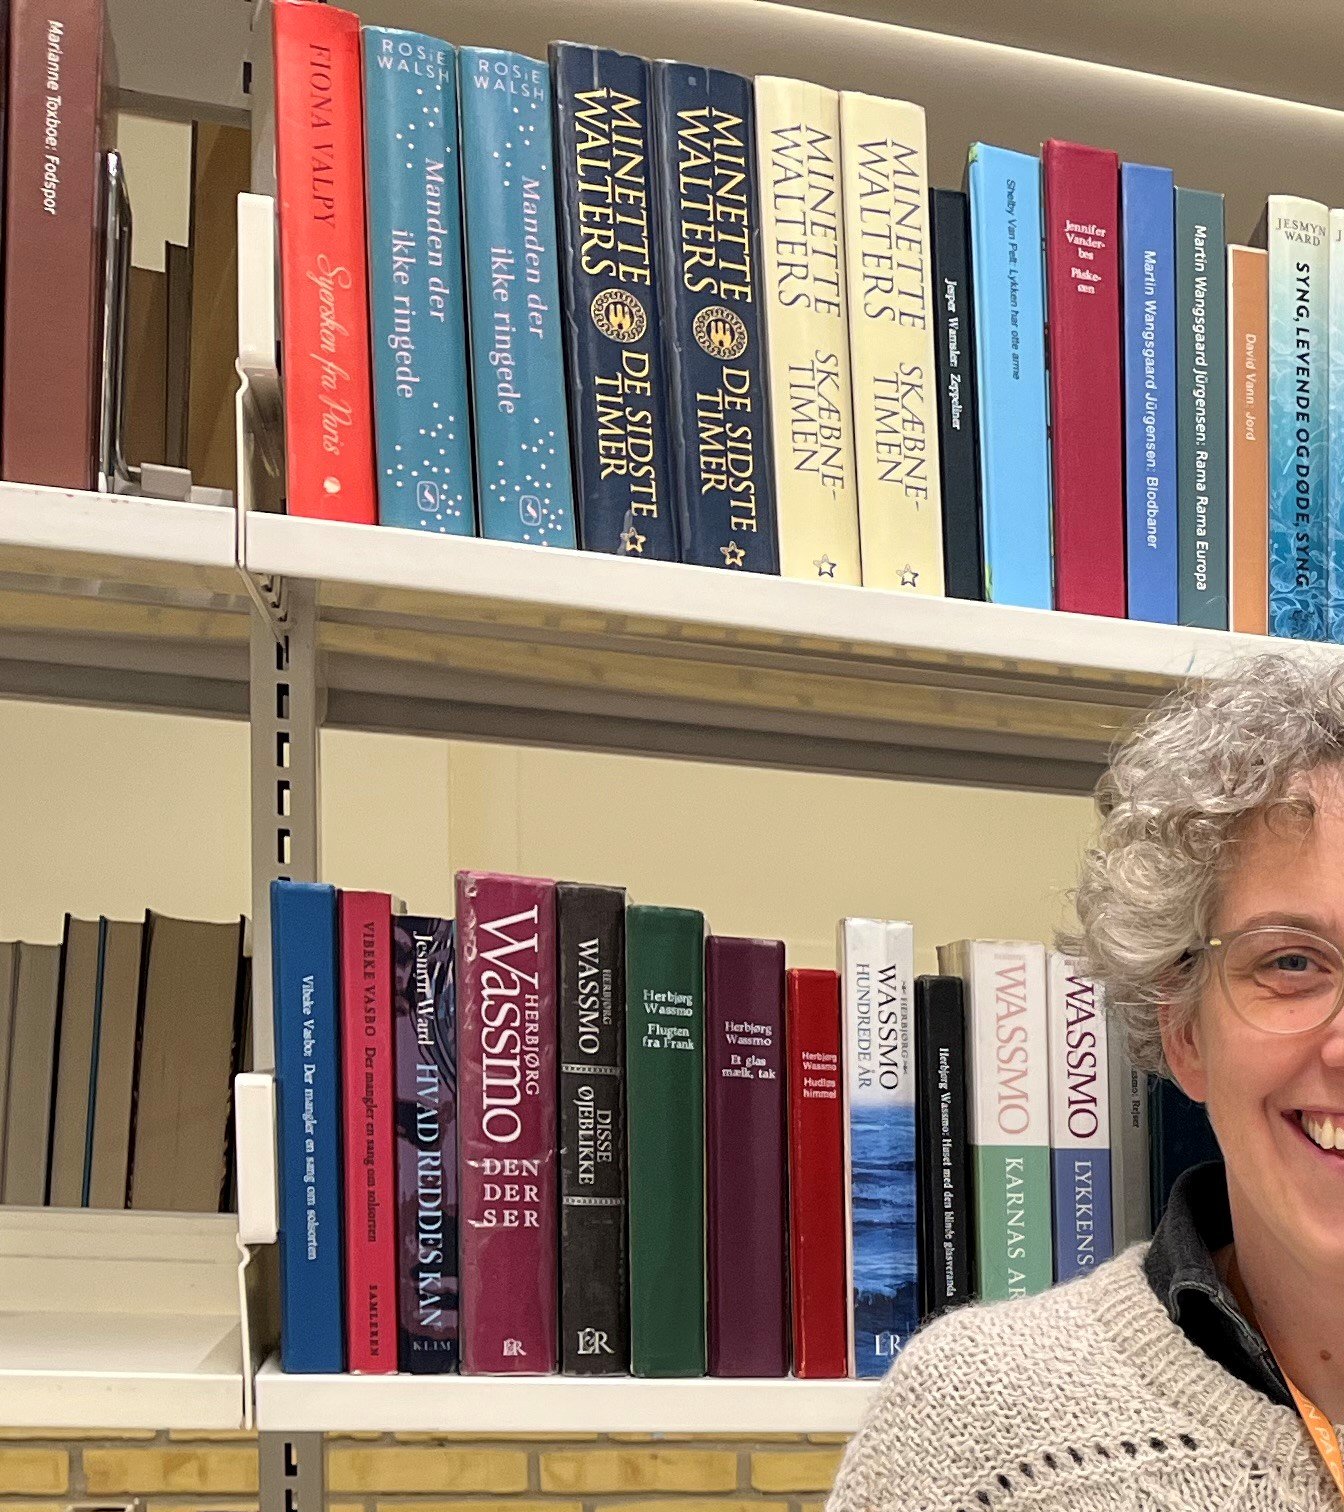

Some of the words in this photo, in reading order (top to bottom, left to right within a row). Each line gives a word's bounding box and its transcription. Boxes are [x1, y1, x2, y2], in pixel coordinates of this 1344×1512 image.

[47, 20, 66, 91] Marianne
[308, 42, 331, 130] FIONA
[376, 54, 450, 83] WALSH
[41, 155, 60, 215] Fodspor
[312, 143, 335, 226] VALPY
[426, 158, 450, 267] Manden
[574, 88, 616, 276] WALTERS
[609, 88, 652, 286] MINETTE
[771, 124, 811, 307] WALTERS
[806, 125, 841, 318] MINETTE
[391, 229, 411, 285] ikke
[1276, 217, 1326, 237] JESMYN
[1284, 231, 1321, 248] WARD
[305, 253, 351, 348] Syersken
[430, 276, 450, 323] der
[1143, 250, 1157, 296] Martin
[1294, 262, 1311, 323] SYNG,
[309, 351, 351, 391] fra
[389, 295, 420, 399] ringede
[622, 350, 651, 396] DE
[1143, 299, 1157, 390] Wangsgaard
[1295, 327, 1311, 422] LEVENDE
[318, 394, 353, 456] Paris
[595, 374, 628, 479] TIMER
[788, 365, 820, 472] TIMEN
[815, 350, 844, 501] SKÆBNE-
[1297, 424, 1310, 456] OG
[626, 408, 657, 518] SIDSTE
[1145, 476, 1159, 550] Blodbaner
[1297, 530, 1310, 587] SYNG
[479, 905, 538, 1144] Wassmo
[578, 938, 599, 1054] WASSMO
[725, 1020, 772, 1036] Herbjørg
[856, 963, 870, 1057] HUNDREDE
[878, 963, 899, 1090] WASSMO
[525, 993, 539, 1095] HERBJØRG
[725, 1034, 771, 1047] Wassmo
[731, 1055, 746, 1066] Et
[748, 1055, 766, 1068] glas
[757, 1067, 775, 1079] tak
[995, 959, 1029, 1135] WASSMO
[1064, 973, 1098, 1139] WASSMO
[416, 1065, 437, 1142] HVAD
[579, 1086, 593, 1185] ØJEBLIKKE
[596, 1110, 611, 1163] DISSE
[417, 1150, 442, 1261] REDDES
[483, 1159, 538, 1177] DEN
[484, 1183, 539, 1203] DER
[1005, 1157, 1026, 1259] KARNAS
[484, 1209, 539, 1228] SER
[1075, 1160, 1093, 1265] LYKKENS
[419, 1268, 442, 1327] KAN
